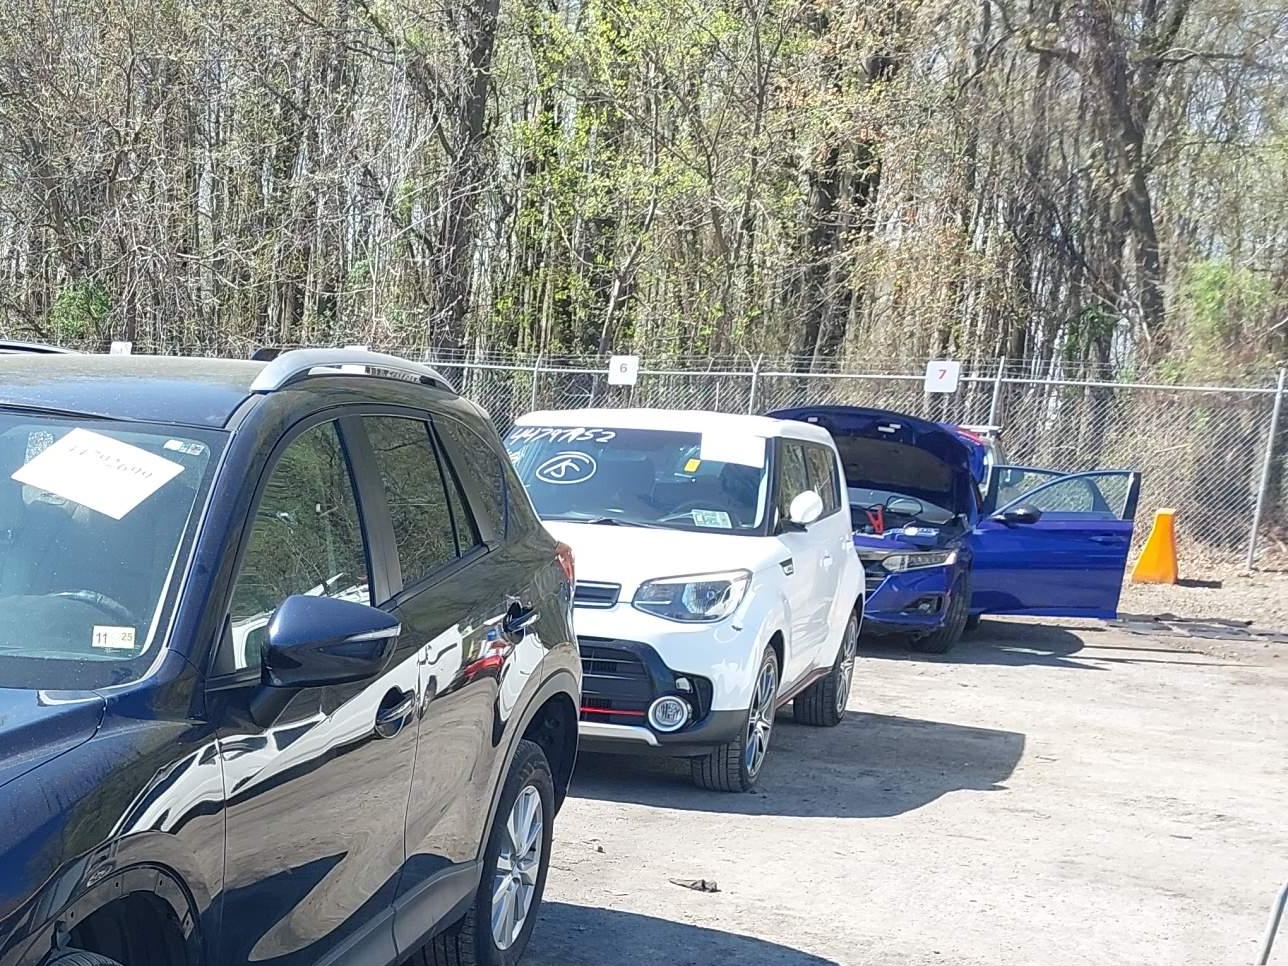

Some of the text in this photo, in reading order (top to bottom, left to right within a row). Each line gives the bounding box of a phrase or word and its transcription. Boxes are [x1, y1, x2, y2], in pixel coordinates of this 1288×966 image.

[619, 363, 628, 373] 6
[938, 369, 948, 380] 7
[96, 632, 133, 645] 11 25
